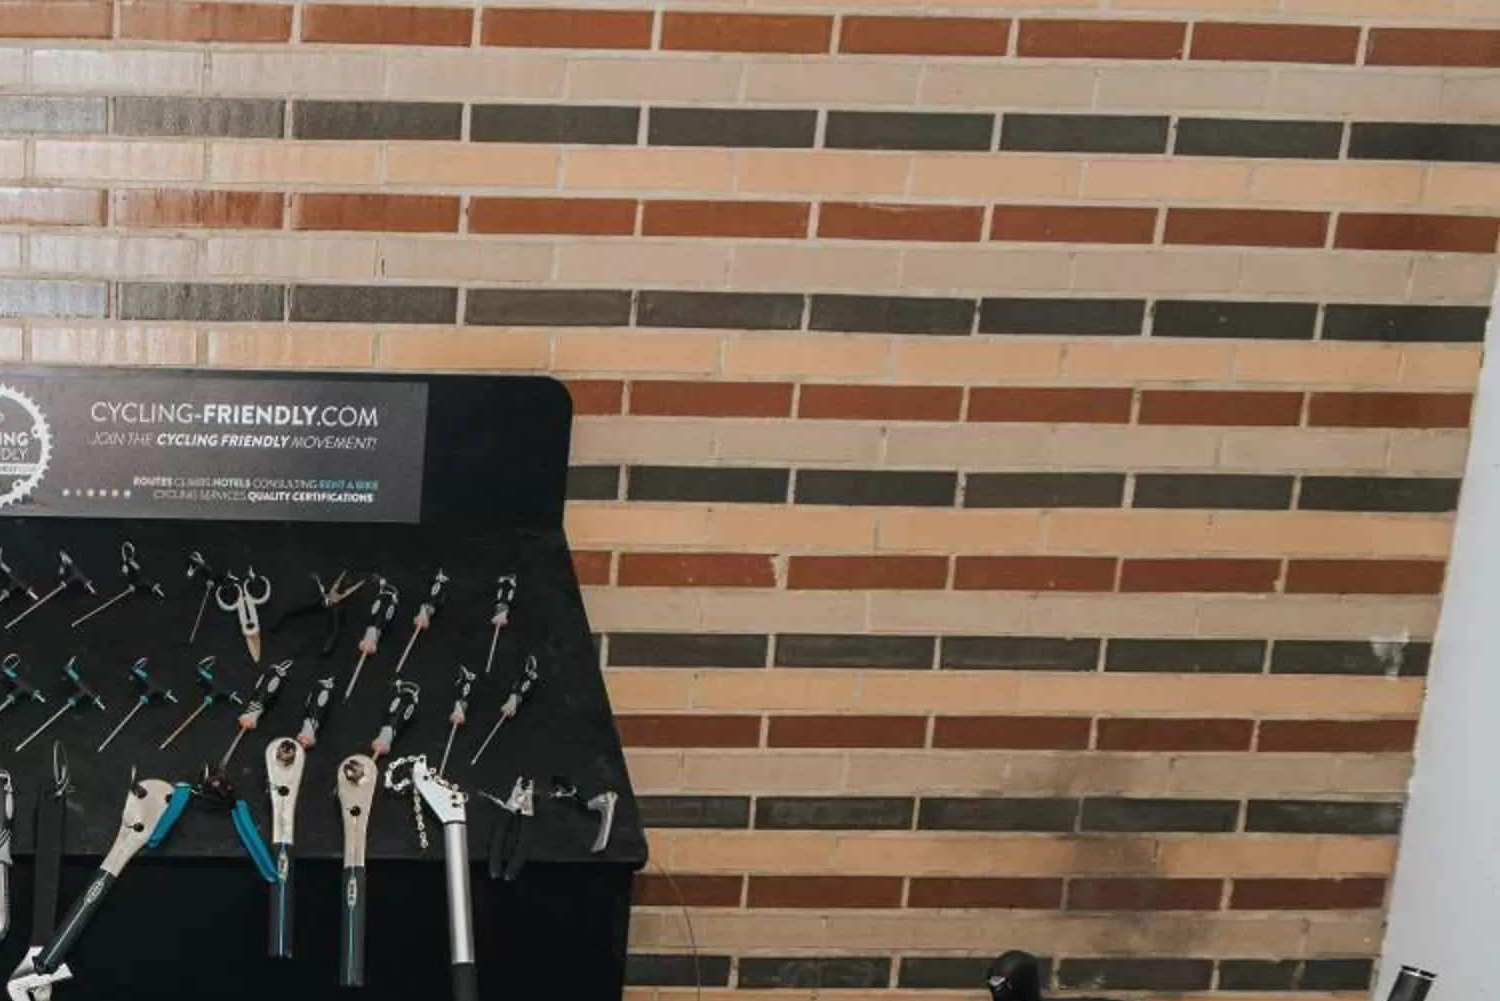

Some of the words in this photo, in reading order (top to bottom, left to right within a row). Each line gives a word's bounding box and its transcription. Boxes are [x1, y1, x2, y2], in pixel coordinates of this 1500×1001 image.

[90, 401, 378, 427] CYCLING-FRIENDLY.COM
[157, 432, 217, 447] CYCLING
[219, 433, 290, 448] FRIENDLY
[247, 491, 291, 503] QUALITY
[292, 492, 374, 503] CERTIFICATIONS
